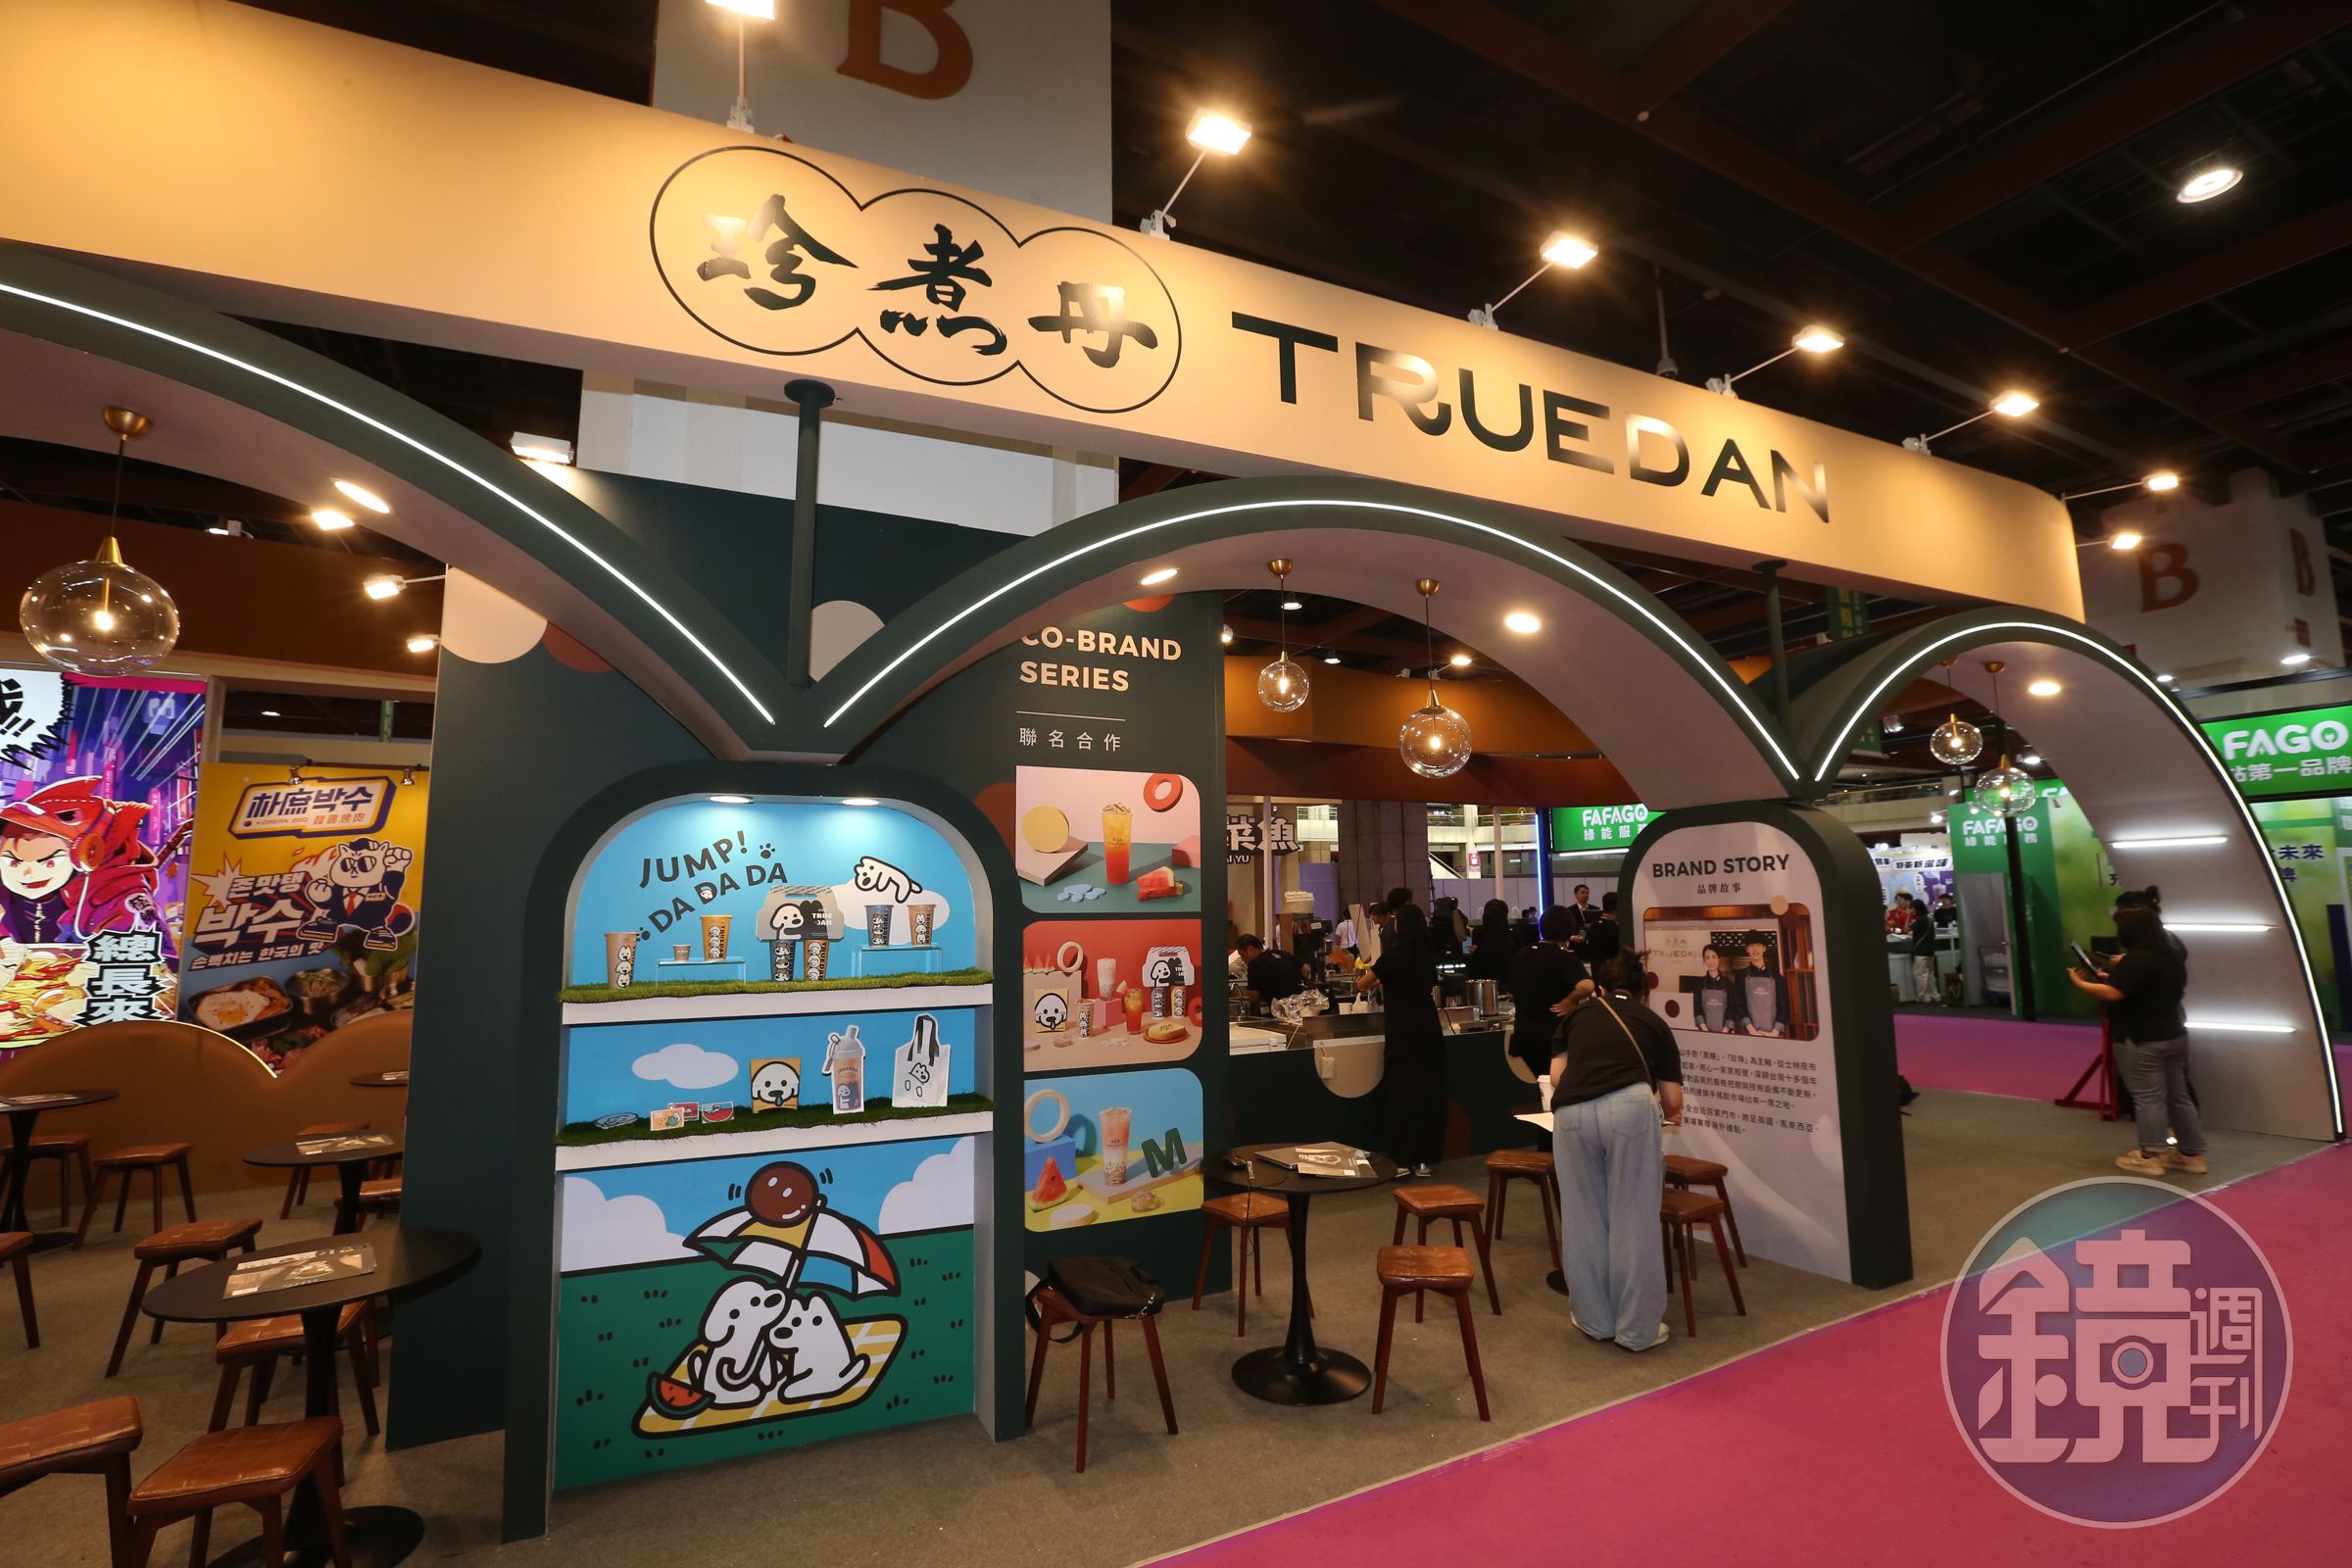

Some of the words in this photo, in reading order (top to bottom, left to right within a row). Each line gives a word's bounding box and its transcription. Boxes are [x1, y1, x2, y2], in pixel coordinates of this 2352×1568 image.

[696, 194, 1158, 368] 珍煮丹
[1231, 311, 1831, 523] TRUEDAN
[2136, 543, 2199, 613] B
[1019, 661, 1129, 692] SERIES
[1019, 727, 1121, 752] 聯名合作
[2210, 720, 2349, 760] FAGO
[1583, 803, 1648, 827] FAFAGO
[639, 830, 748, 889] JUMP!
[1965, 833, 2037, 847] 綠能務
[1652, 859, 1717, 878] BRAND
[1723, 854, 1789, 873] STORY
[648, 897, 696, 933] DA
[746, 862, 788, 886] DA
[1697, 882, 1741, 895] 品牌故事
[194, 899, 305, 949] 박수
[258, 943, 304, 960] 한국의
[309, 941, 324, 955] 맛
[1141, 1127, 1188, 1178] M
